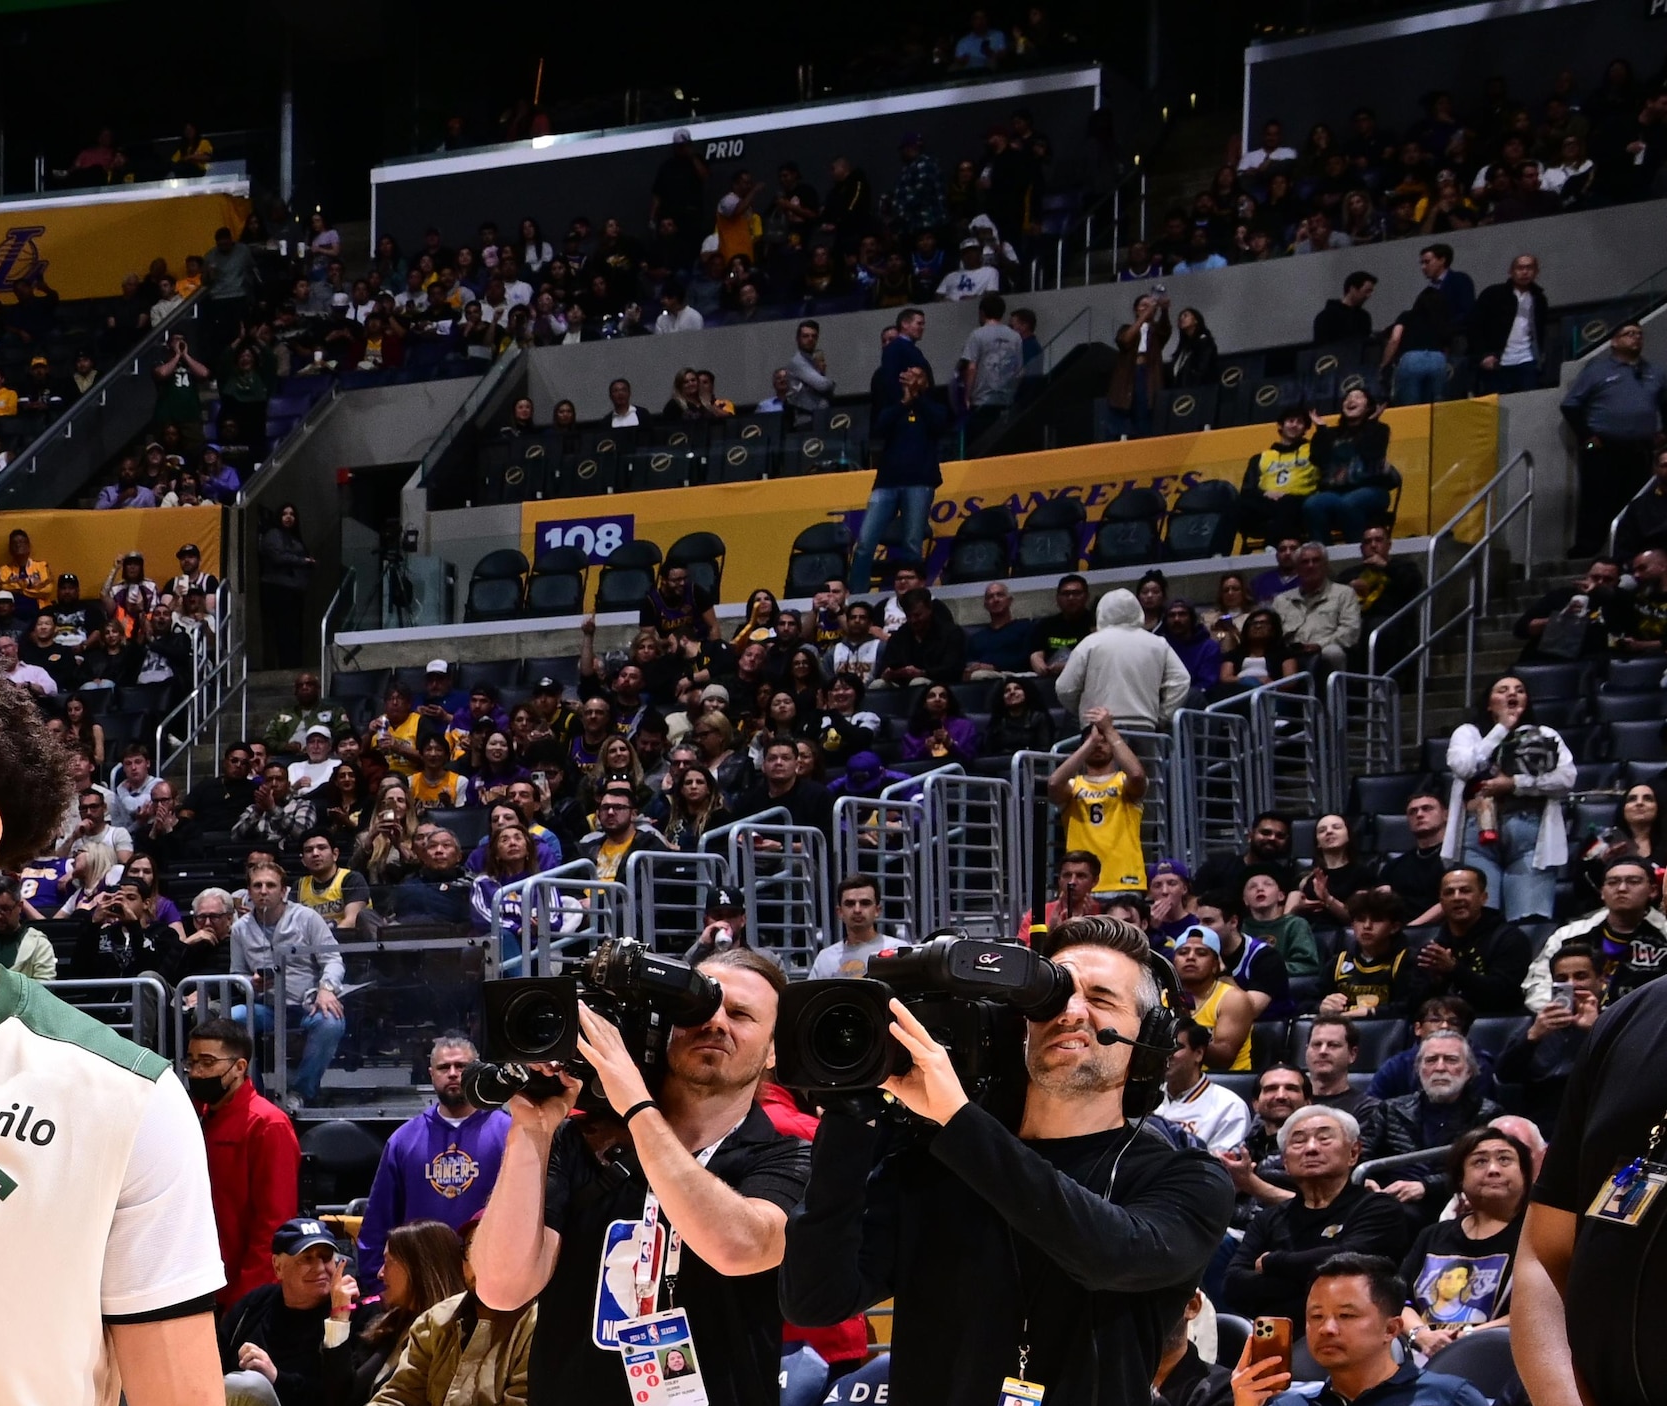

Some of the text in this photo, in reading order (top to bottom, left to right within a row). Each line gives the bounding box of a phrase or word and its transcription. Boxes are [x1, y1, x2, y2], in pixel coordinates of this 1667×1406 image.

[707, 140, 743, 160] PR10
[175, 373, 190, 388] 34
[545, 523, 623, 556] 108
[1090, 803, 1104, 826] 6
[424, 1161, 480, 1180] LAKERS
[300, 1222, 321, 1237] M
[661, 1325, 678, 1337] SEASON
